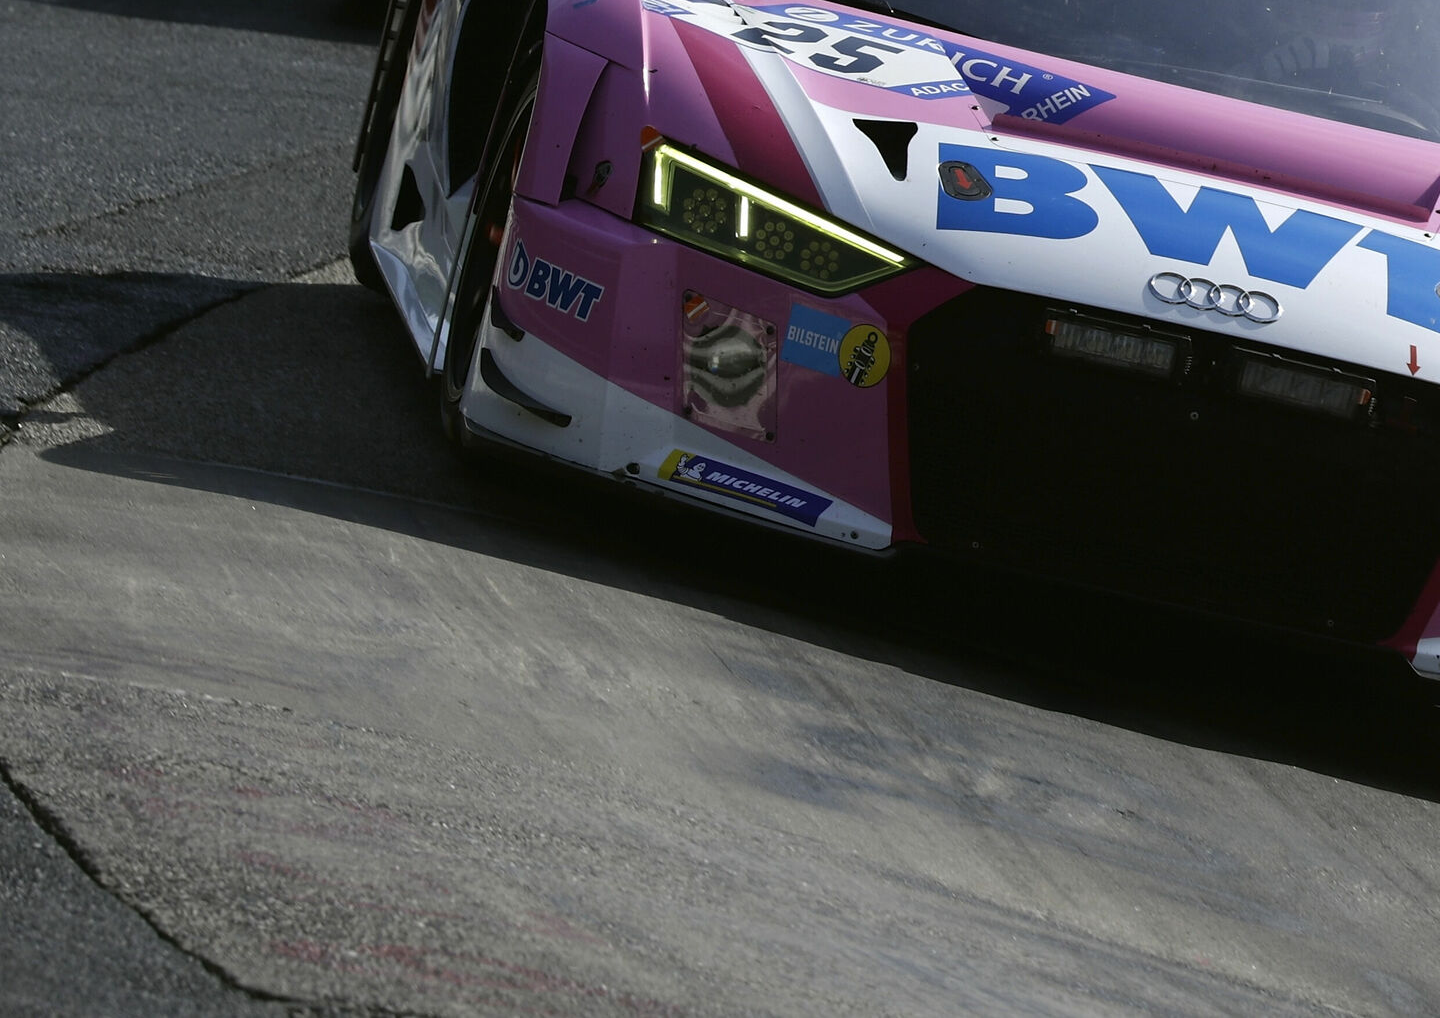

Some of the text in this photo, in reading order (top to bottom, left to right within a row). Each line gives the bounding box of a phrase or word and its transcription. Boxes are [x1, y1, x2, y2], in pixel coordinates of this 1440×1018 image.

[731, 20, 906, 75] 25
[910, 83, 970, 97] ADAC
[524, 257, 605, 322] BWT
[787, 325, 840, 355] BILSTEIN
[706, 471, 808, 509] MICHELIN
